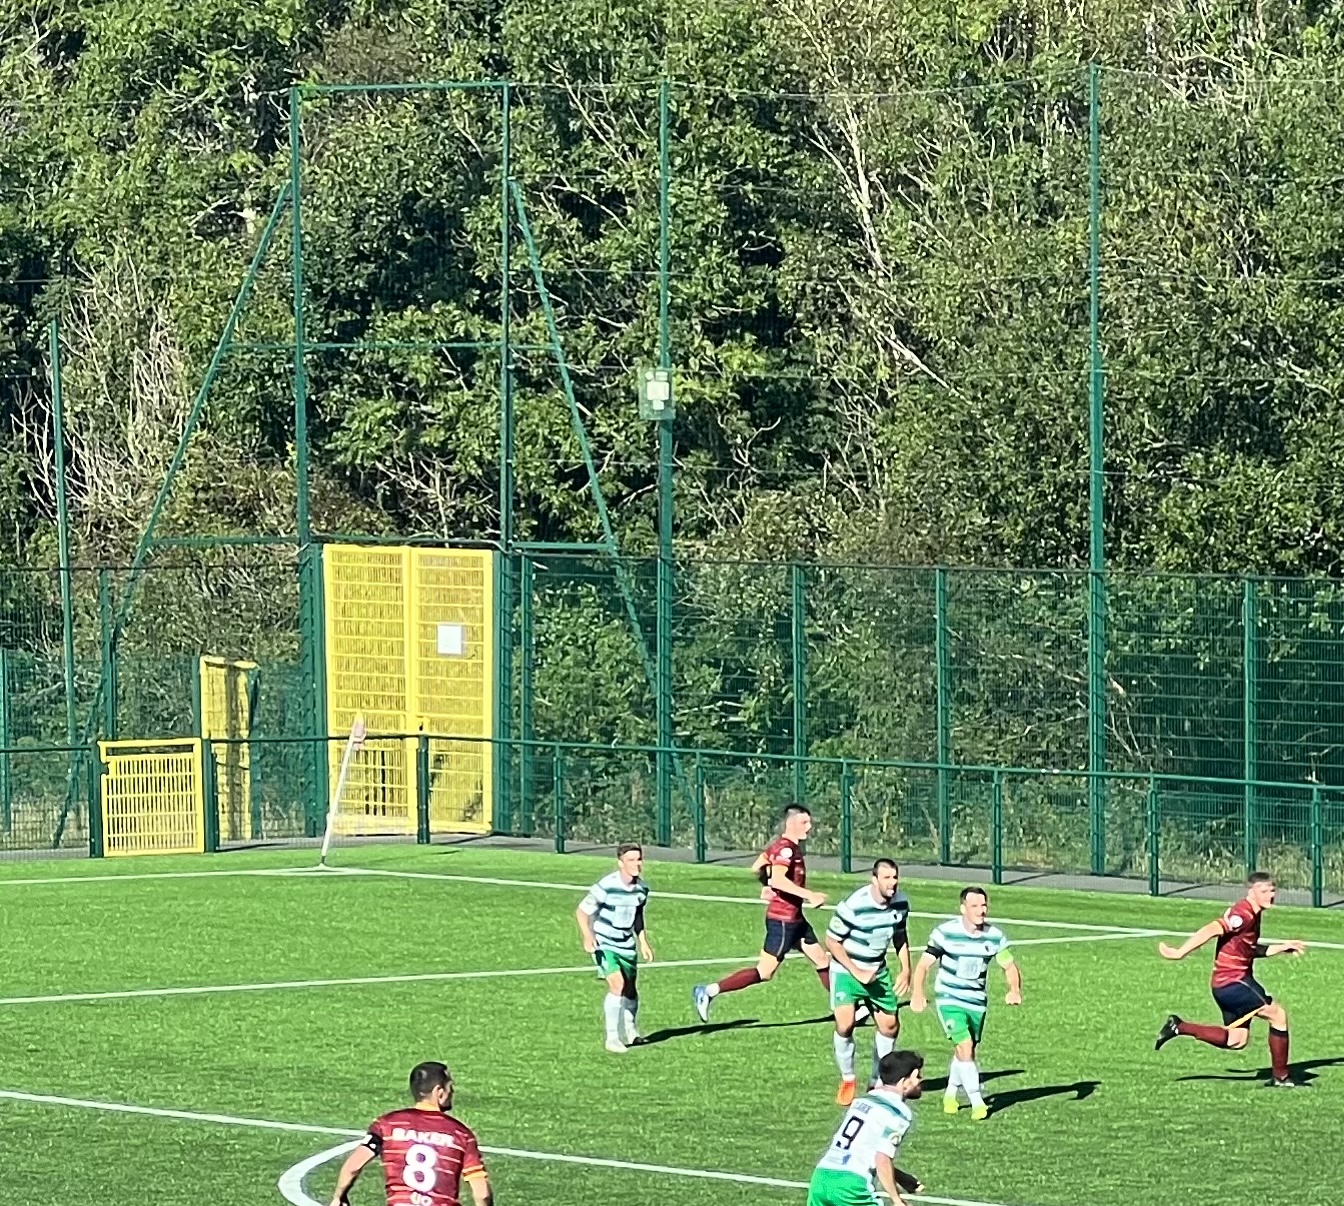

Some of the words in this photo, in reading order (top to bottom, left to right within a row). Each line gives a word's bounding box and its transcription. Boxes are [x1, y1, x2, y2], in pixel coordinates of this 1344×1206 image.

[392, 1127, 455, 1148] BAKER
[835, 1115, 865, 1151] 9
[403, 1143, 437, 1192] 8
